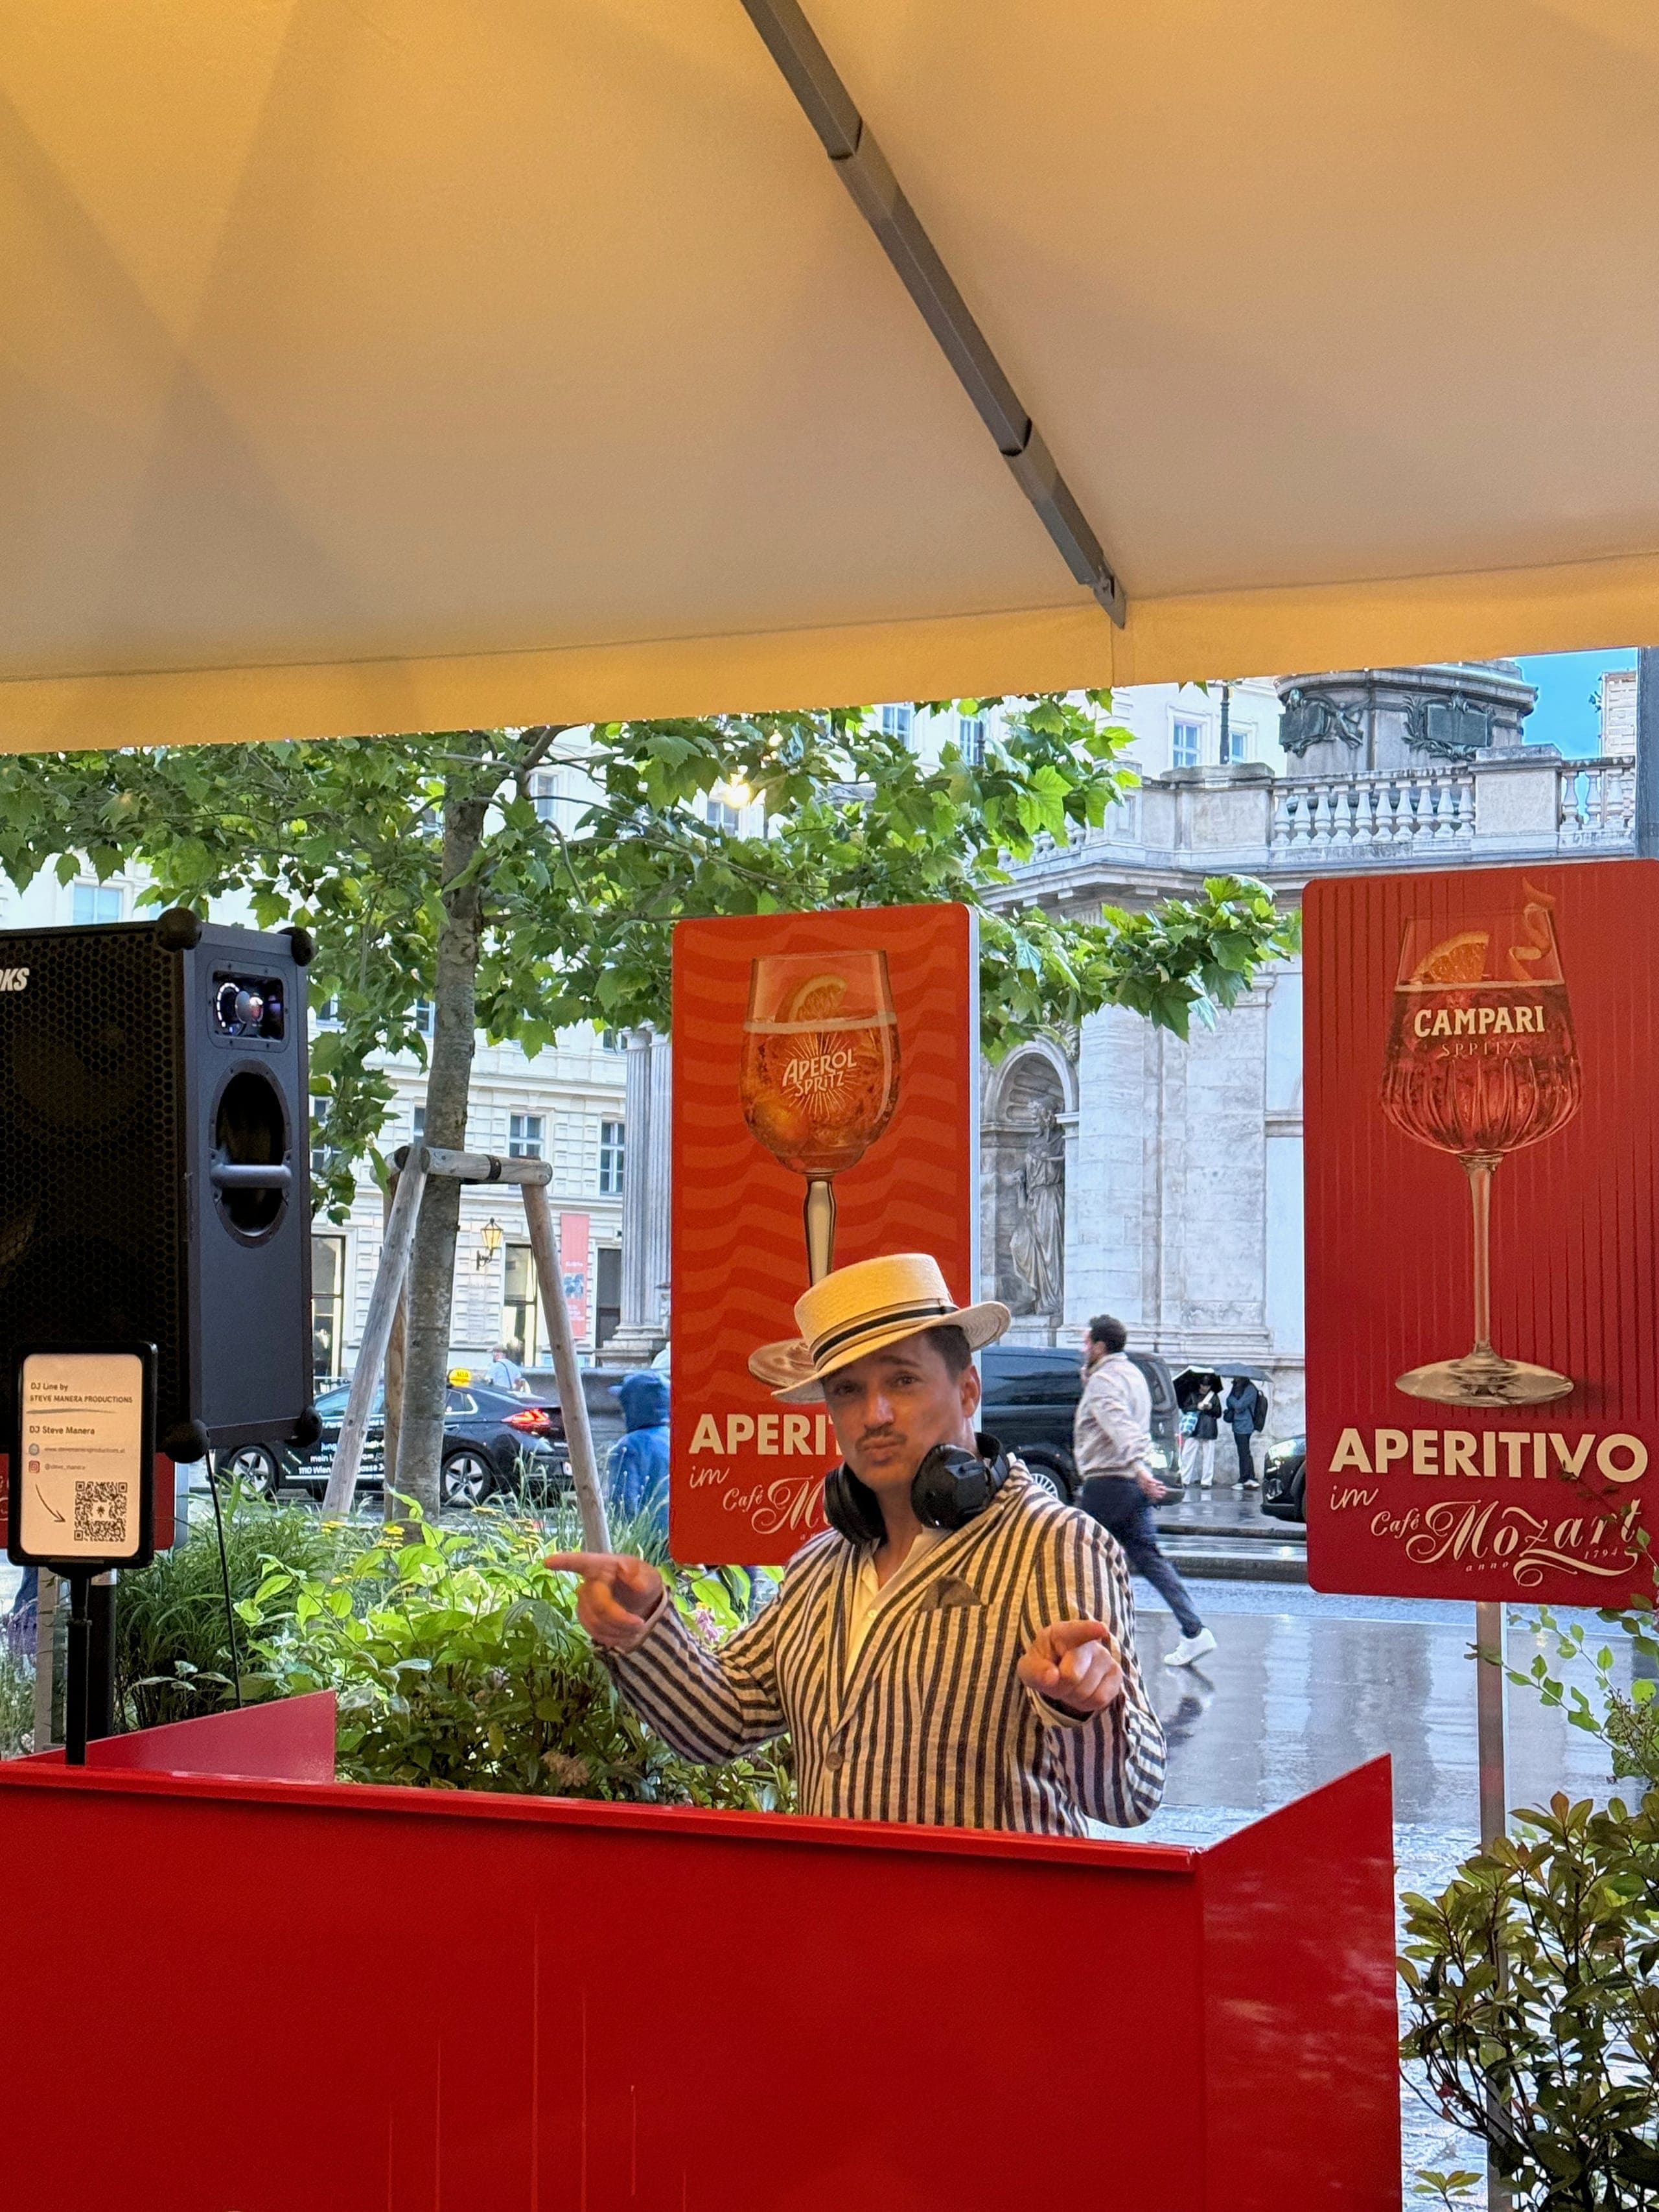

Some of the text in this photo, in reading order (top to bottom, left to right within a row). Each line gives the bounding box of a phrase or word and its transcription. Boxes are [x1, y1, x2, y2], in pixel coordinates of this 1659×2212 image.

[0, 968, 30, 992] KS
[1414, 1006, 1546, 1038] CAMPARI
[782, 1048, 857, 1088] APEROL
[29, 1425, 40, 1434] DJ
[1328, 1428, 1649, 1483] APERITIVO
[689, 1465, 730, 1489] im
[723, 1484, 763, 1513] Café
[1329, 1485, 1379, 1511] im
[1370, 1498, 1642, 1586] Café Mozart
[1465, 1561, 1509, 1572] anno
